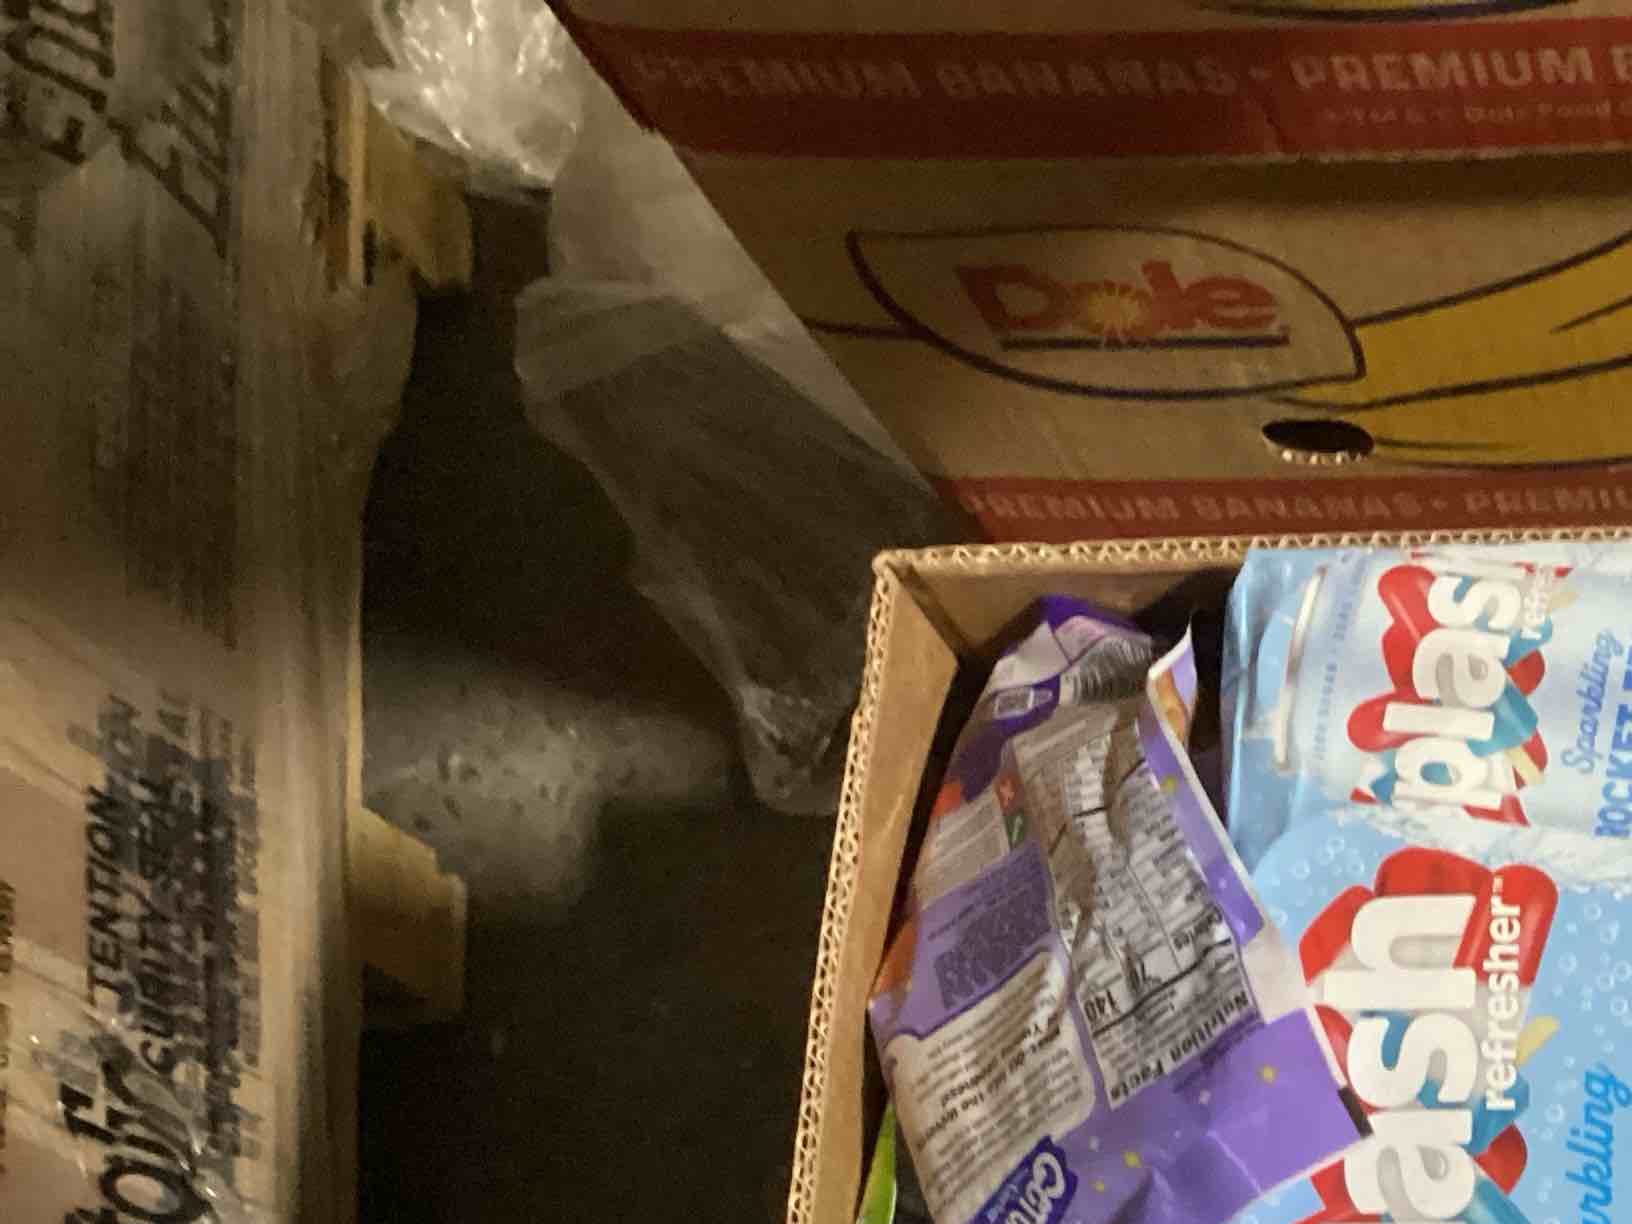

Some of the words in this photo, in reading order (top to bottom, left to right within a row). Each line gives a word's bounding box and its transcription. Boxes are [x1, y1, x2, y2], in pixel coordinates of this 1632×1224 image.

[1292, 44, 1594, 91] PREMIUM
[956, 260, 1279, 338] Dole
[1482, 899, 1523, 1112] refresher
